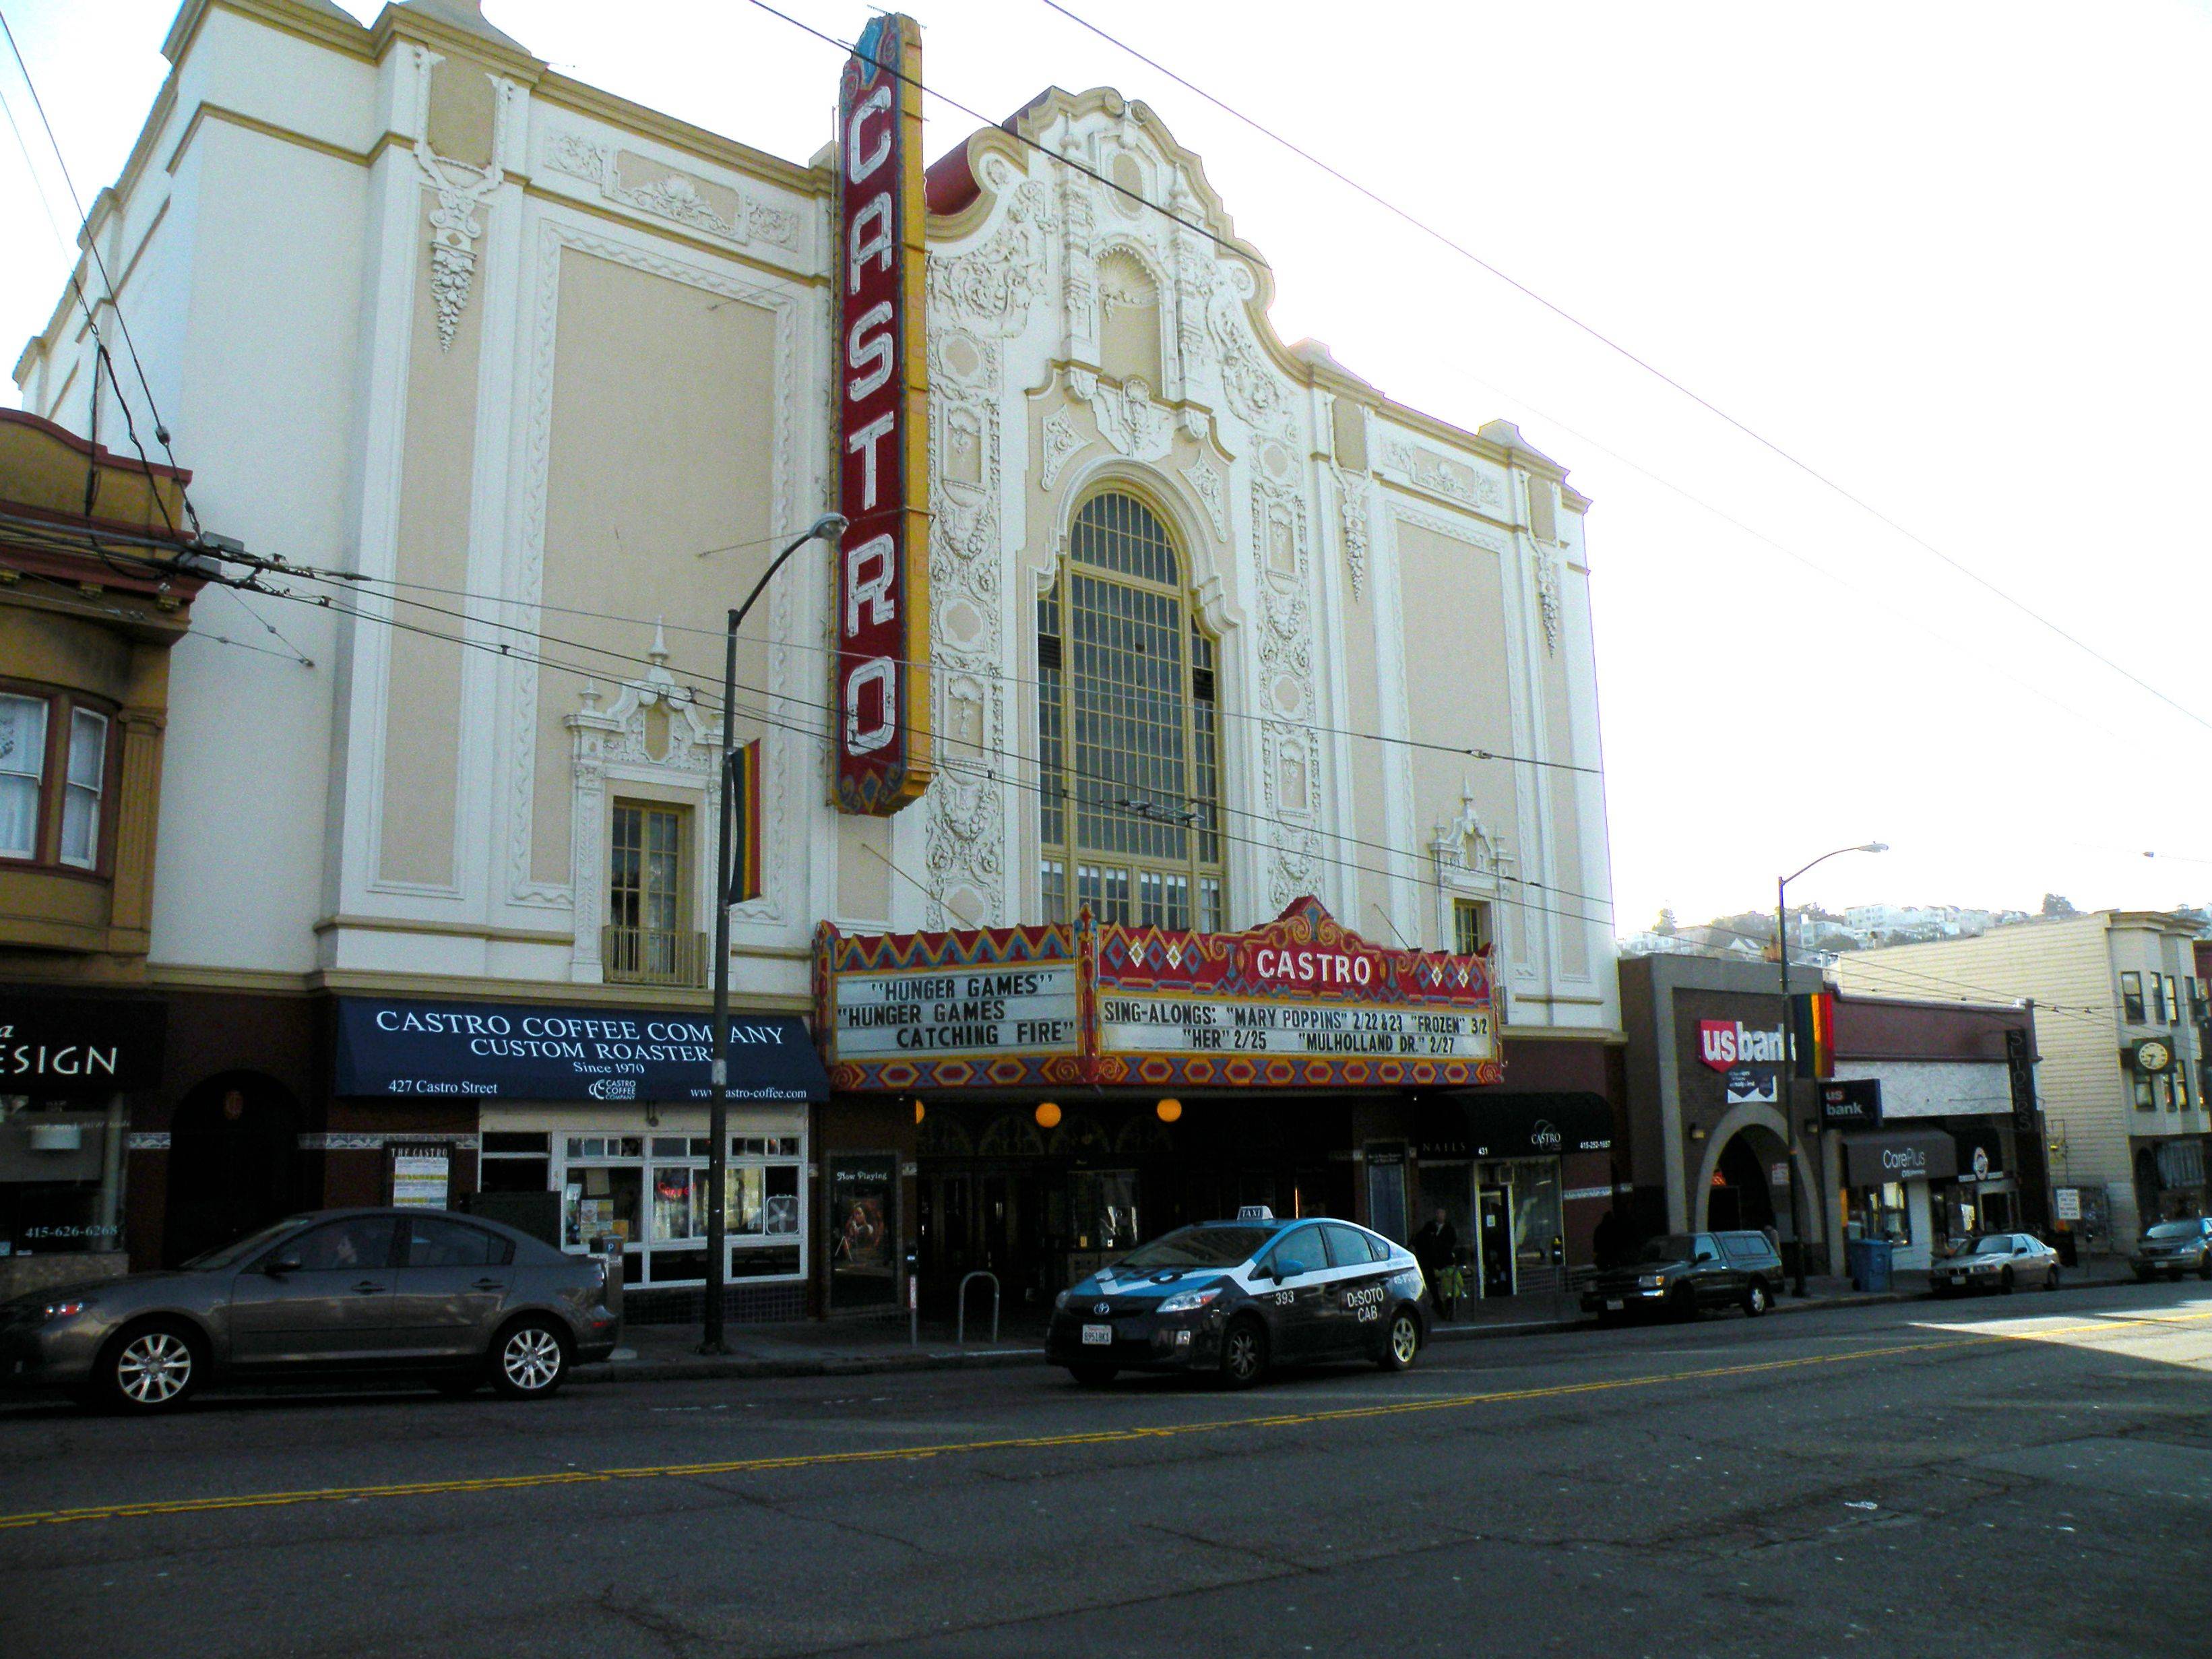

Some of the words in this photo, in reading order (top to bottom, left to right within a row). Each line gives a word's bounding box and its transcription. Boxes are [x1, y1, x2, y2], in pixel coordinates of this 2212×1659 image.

[846, 85, 895, 756] CASTRO
[1257, 949, 1372, 985] CASTRO
[934, 1000, 1005, 1023] GAMES
[1104, 1001, 1217, 1025] SING-ALONGS:
[1226, 1007, 1276, 1027] "MARY
[1283, 1009, 1348, 1030] POPPINS"
[1352, 1012, 1379, 1030] 2/22
[1411, 1014, 1465, 1034] "FROZEN"
[1471, 1018, 1488, 1034] 3/2
[376, 1011, 511, 1035] CASTRO
[522, 1017, 640, 1040] COFFEE
[647, 1022, 784, 1044] COMANY
[896, 1024, 999, 1047] CATCHING
[1183, 1028, 1230, 1048] "HER"
[1234, 1030, 1267, 1050] 2/25
[1298, 1032, 1393, 1052] "MULHOLLAND
[1430, 1036, 1455, 1053] 2/27
[470, 1038, 586, 1059] CUSTOM
[596, 1043, 714, 1062] ROASTER
[573, 1061, 611, 1073] Since
[615, 1063, 645, 1074] 1970
[389, 1079, 412, 1092] 427
[416, 1080, 458, 1094] Castro
[462, 1080, 498, 1094] Street
[606, 1079, 636, 1087] CASTRO
[1826, 1102, 1864, 1115] bank
[1531, 1132, 1561, 1145] CASTRO
[1422, 1142, 1465, 1153] NAILS
[1883, 1148, 1926, 1169] CarePlus
[857, 1170, 888, 1181] Playing
[1242, 1209, 1261, 1218] TAXI
[25, 1224, 119, 1238] 415-626-6268
[1275, 1290, 1294, 1306] 393
[1357, 1305, 1378, 1323] CAB
